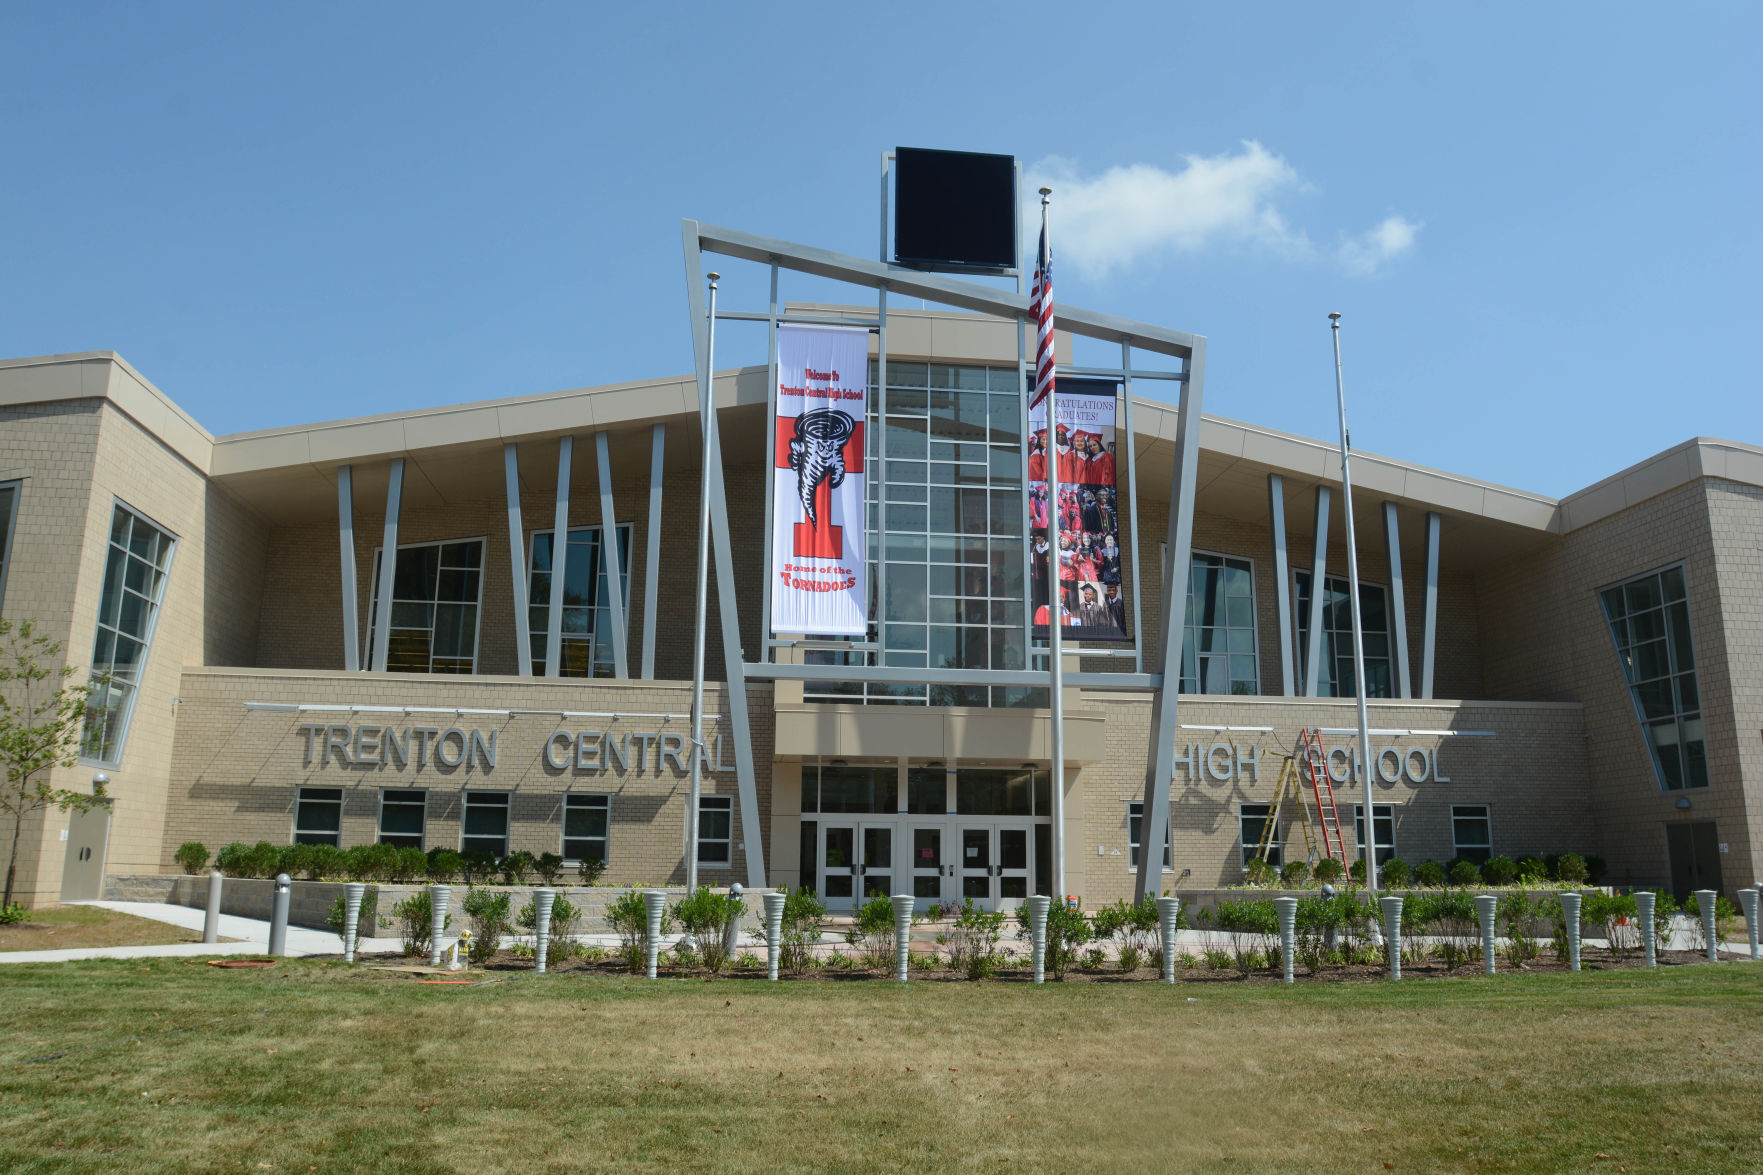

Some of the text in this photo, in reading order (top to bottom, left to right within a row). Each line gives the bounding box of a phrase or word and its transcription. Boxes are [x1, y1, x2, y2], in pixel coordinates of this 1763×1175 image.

[805, 368, 840, 381] Welcome To
[780, 384, 863, 401] Trenton Central High School
[1037, 398, 1114, 411] ONRATULATIONS
[1046, 410, 1099, 421] ADUATES!
[784, 563, 853, 575] Home of the
[780, 572, 856, 592] TORNADOES
[300, 723, 736, 772] TRENTON CENTRAL
[1171, 743, 1450, 783] HIGH SCHOOL
